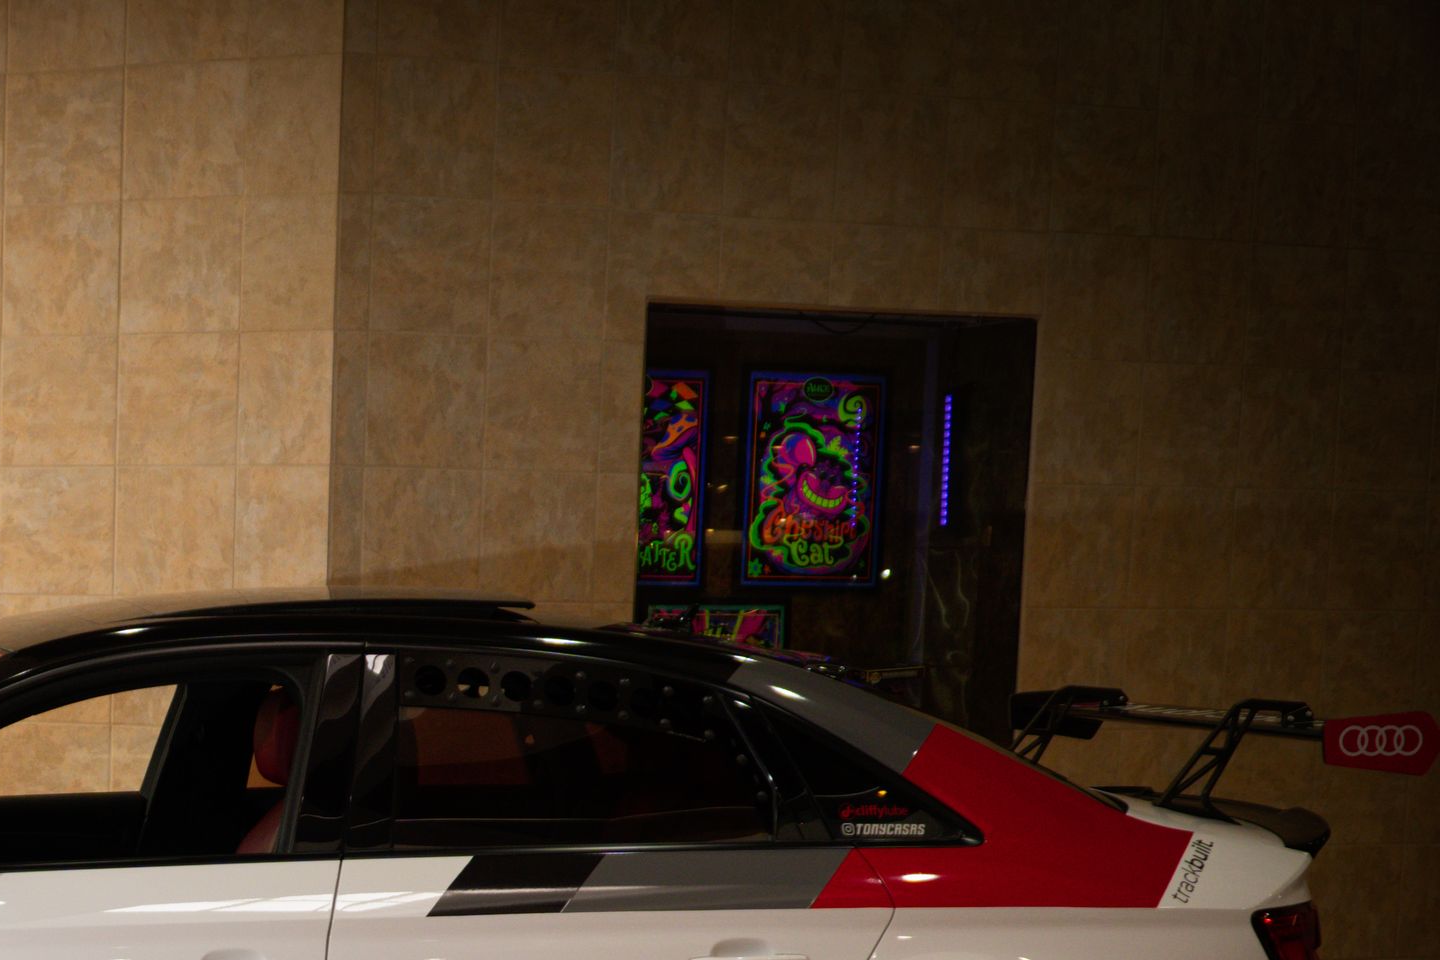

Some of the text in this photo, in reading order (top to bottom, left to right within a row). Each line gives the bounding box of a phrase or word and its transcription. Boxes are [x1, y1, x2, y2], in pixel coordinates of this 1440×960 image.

[639, 534, 697, 572] ATTER
[791, 540, 835, 567] Cat
[1171, 838, 1215, 904] trackbuilt
